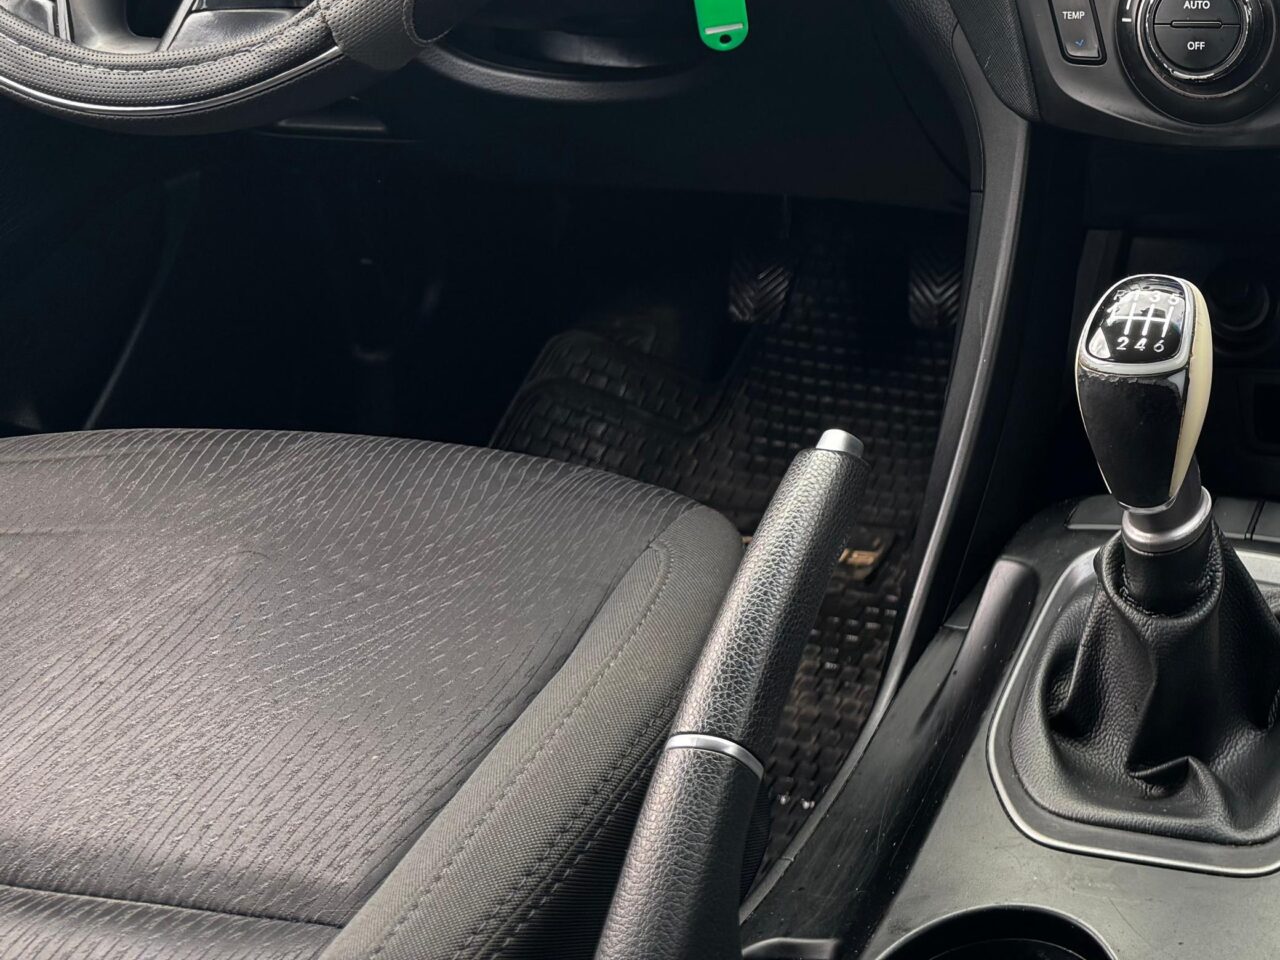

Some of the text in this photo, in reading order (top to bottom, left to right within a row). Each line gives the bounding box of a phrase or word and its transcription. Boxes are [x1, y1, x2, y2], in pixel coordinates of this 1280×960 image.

[1183, 0, 1211, 10] AUTO
[1062, 11, 1085, 20] TEMP
[1187, 41, 1206, 51] OFF
[1149, 291, 1160, 302] 3
[1168, 293, 1179, 305] 5
[1116, 336, 1165, 352] 2 4 6
